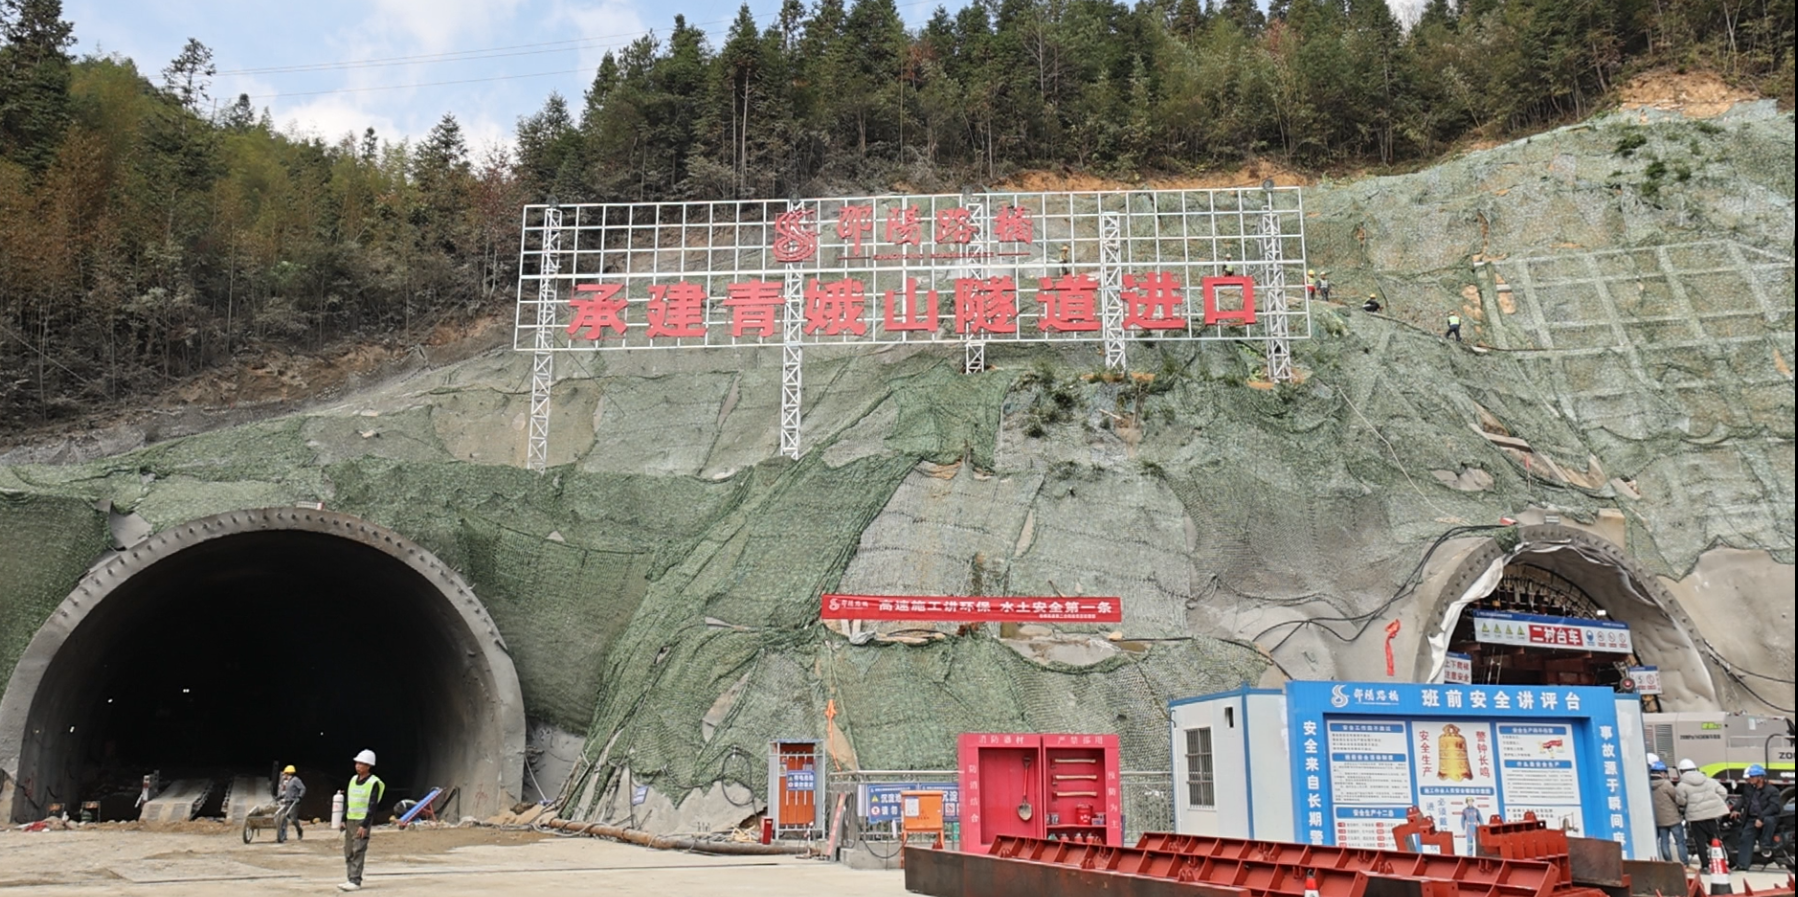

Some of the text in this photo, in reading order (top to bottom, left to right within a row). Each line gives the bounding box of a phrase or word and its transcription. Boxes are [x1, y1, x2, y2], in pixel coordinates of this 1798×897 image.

[568, 271, 1256, 340] 承建青娥山隧道进口
[879, 599, 990, 613] 高速施工讲环保
[1000, 601, 1112, 614] 水土安全第一条
[1444, 670, 1469, 682] 注意安全
[1421, 689, 1581, 710] 班前安全讲评台
[979, 736, 1025, 745] 消防器材
[1057, 736, 1104, 745] 严禁挪用
[1419, 730, 1433, 777] 安全生产
[1475, 731, 1490, 778] 警钟长鸣
[1108, 772, 1119, 829] 预防为主
[1599, 725, 1628, 860] 事故源于瞬间麻
